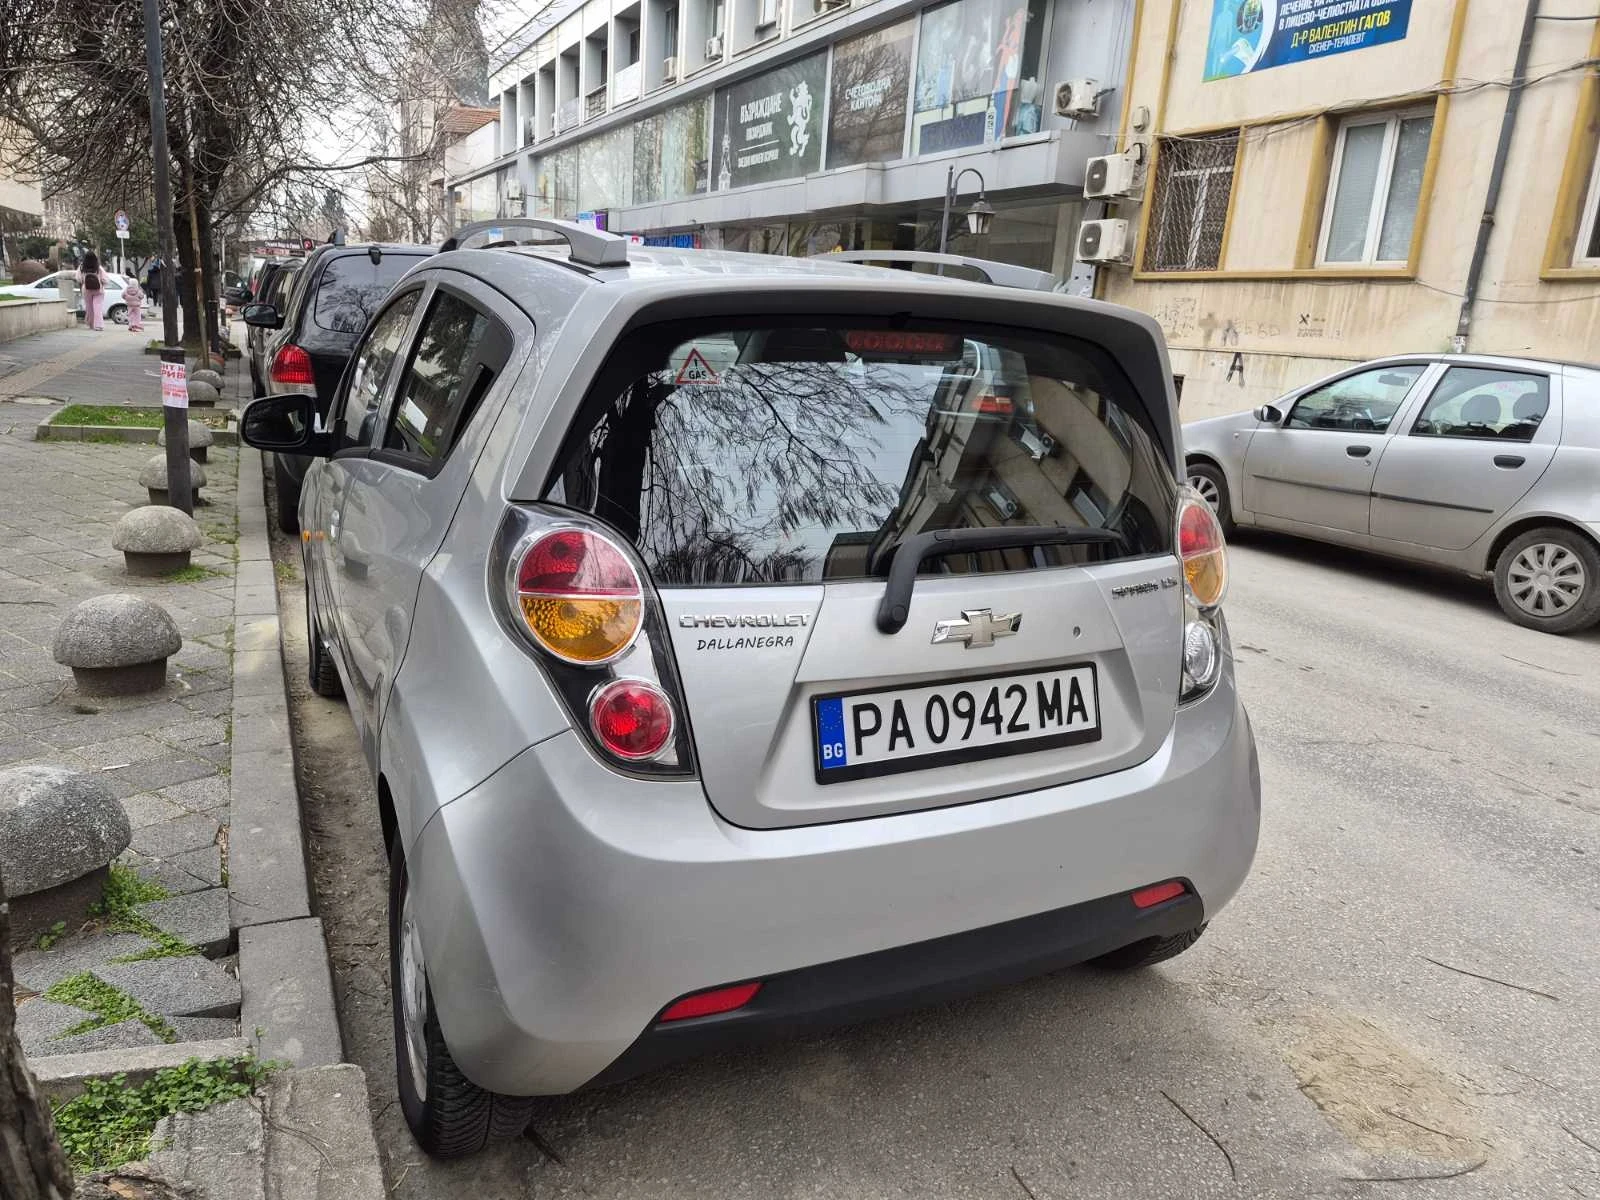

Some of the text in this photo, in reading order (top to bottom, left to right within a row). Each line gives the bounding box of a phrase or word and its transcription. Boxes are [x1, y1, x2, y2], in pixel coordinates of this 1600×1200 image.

[1278, 20, 1284, 30] В
[1291, 10, 1392, 48] Д-Р ВАЛЕНТИН ГАГОВ
[688, 370, 707, 379] GAS
[679, 613, 811, 628] CHEVROLET
[697, 636, 794, 650] DALLANEGRA
[852, 676, 1089, 756] PA 0942 MA
[823, 742, 844, 760] BG
